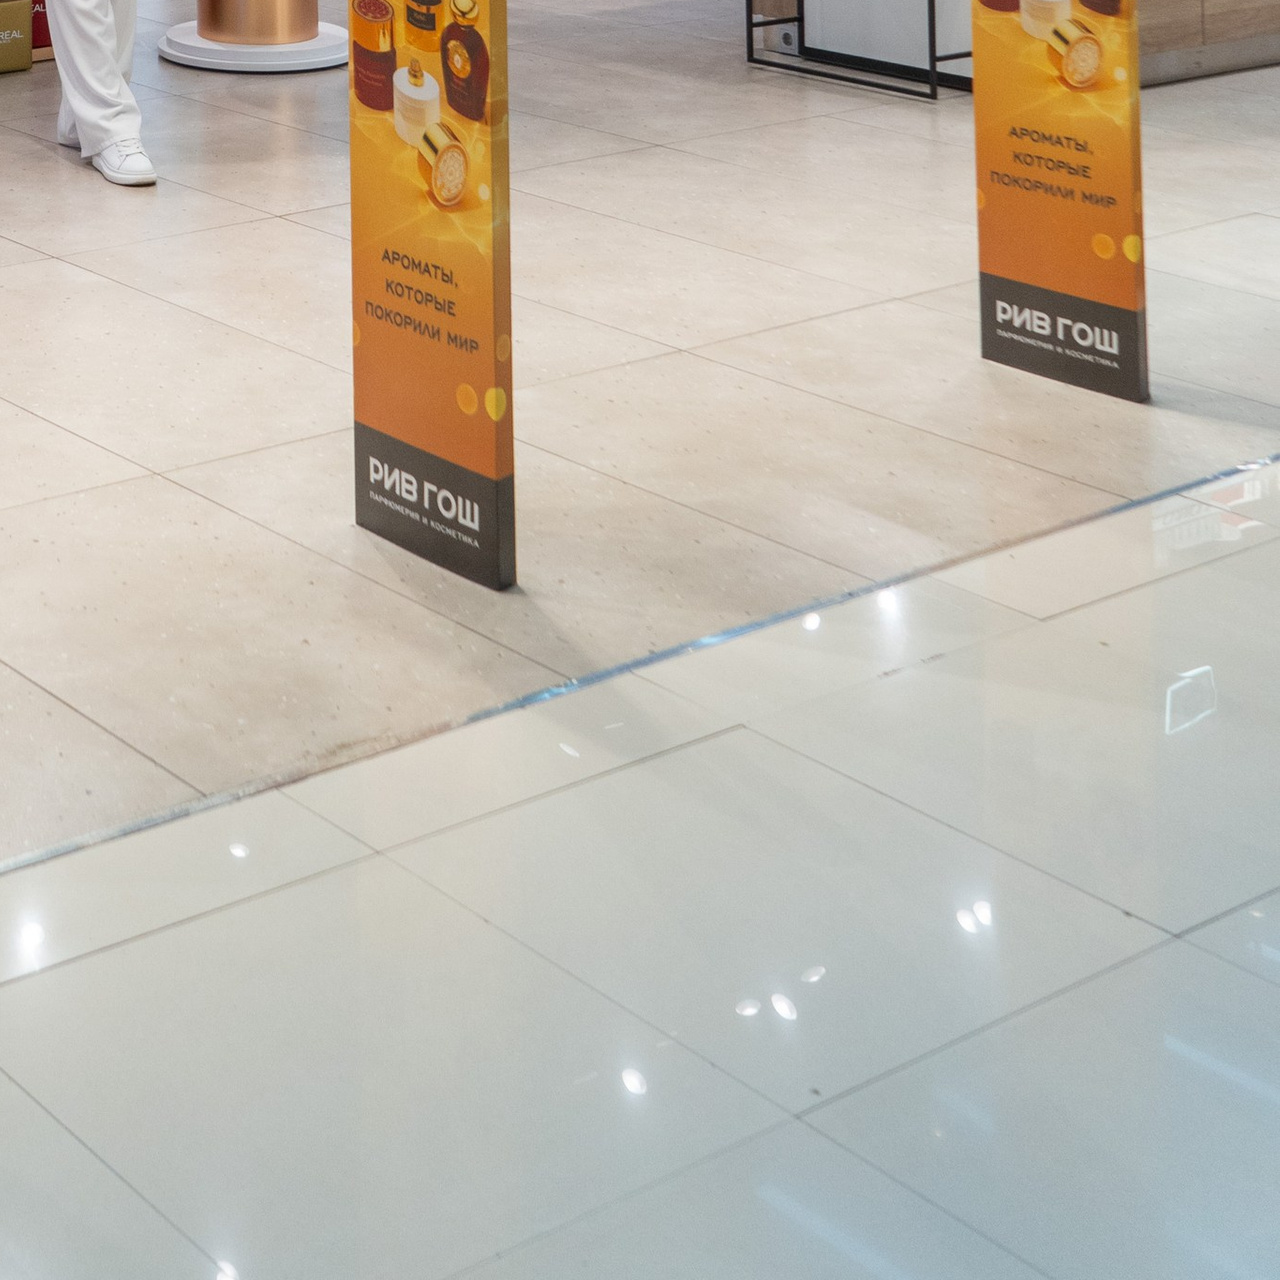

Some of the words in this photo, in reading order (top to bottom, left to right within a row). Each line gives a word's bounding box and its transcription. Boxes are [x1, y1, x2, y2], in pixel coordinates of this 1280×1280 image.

[1008, 126, 1093, 156] АРОМАТЫ,
[1012, 151, 1092, 180] КОТОРЫЕ
[990, 170, 1075, 202] ПОКОРИЛИ
[1081, 189, 1116, 209] МИР
[381, 248, 458, 287] АРОМАТЫ,
[385, 278, 456, 317] КОТОРЫЕ
[365, 301, 441, 341] ПОКОРИЛИ
[447, 331, 479, 354] МИР
[995, 299, 1052, 336] РИВ
[1056, 316, 1119, 356] ГОШ
[369, 455, 418, 503] РИВ
[423, 480, 480, 533] ГОШ
